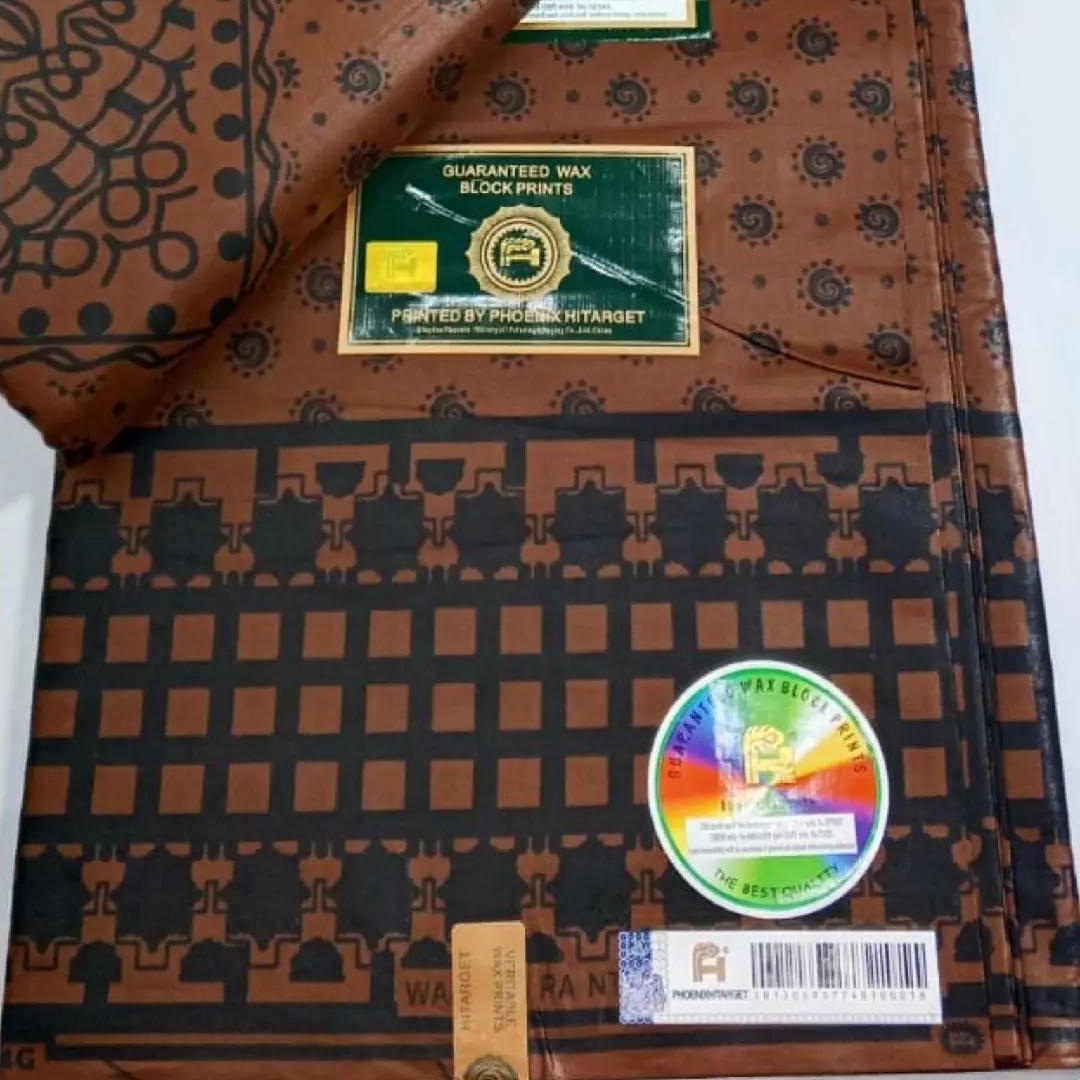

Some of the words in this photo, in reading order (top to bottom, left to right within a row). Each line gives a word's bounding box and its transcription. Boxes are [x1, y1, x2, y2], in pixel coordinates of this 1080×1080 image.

[442, 164, 551, 179] GUARANTEED
[556, 164, 592, 179] WAX
[460, 180, 514, 195] BLOCK
[516, 181, 573, 196] PRINTS
[391, 308, 461, 324] PRINTED
[464, 309, 484, 323] BY
[492, 309, 562, 324] PHOENIX
[564, 310, 646, 325] HITARGET
[668, 686, 735, 780] GUARANTED
[740, 680, 775, 693] WAX
[715, 867, 738, 890] THE
[742, 882, 778, 899] BEST
[458, 949, 472, 1031] HITARGET
